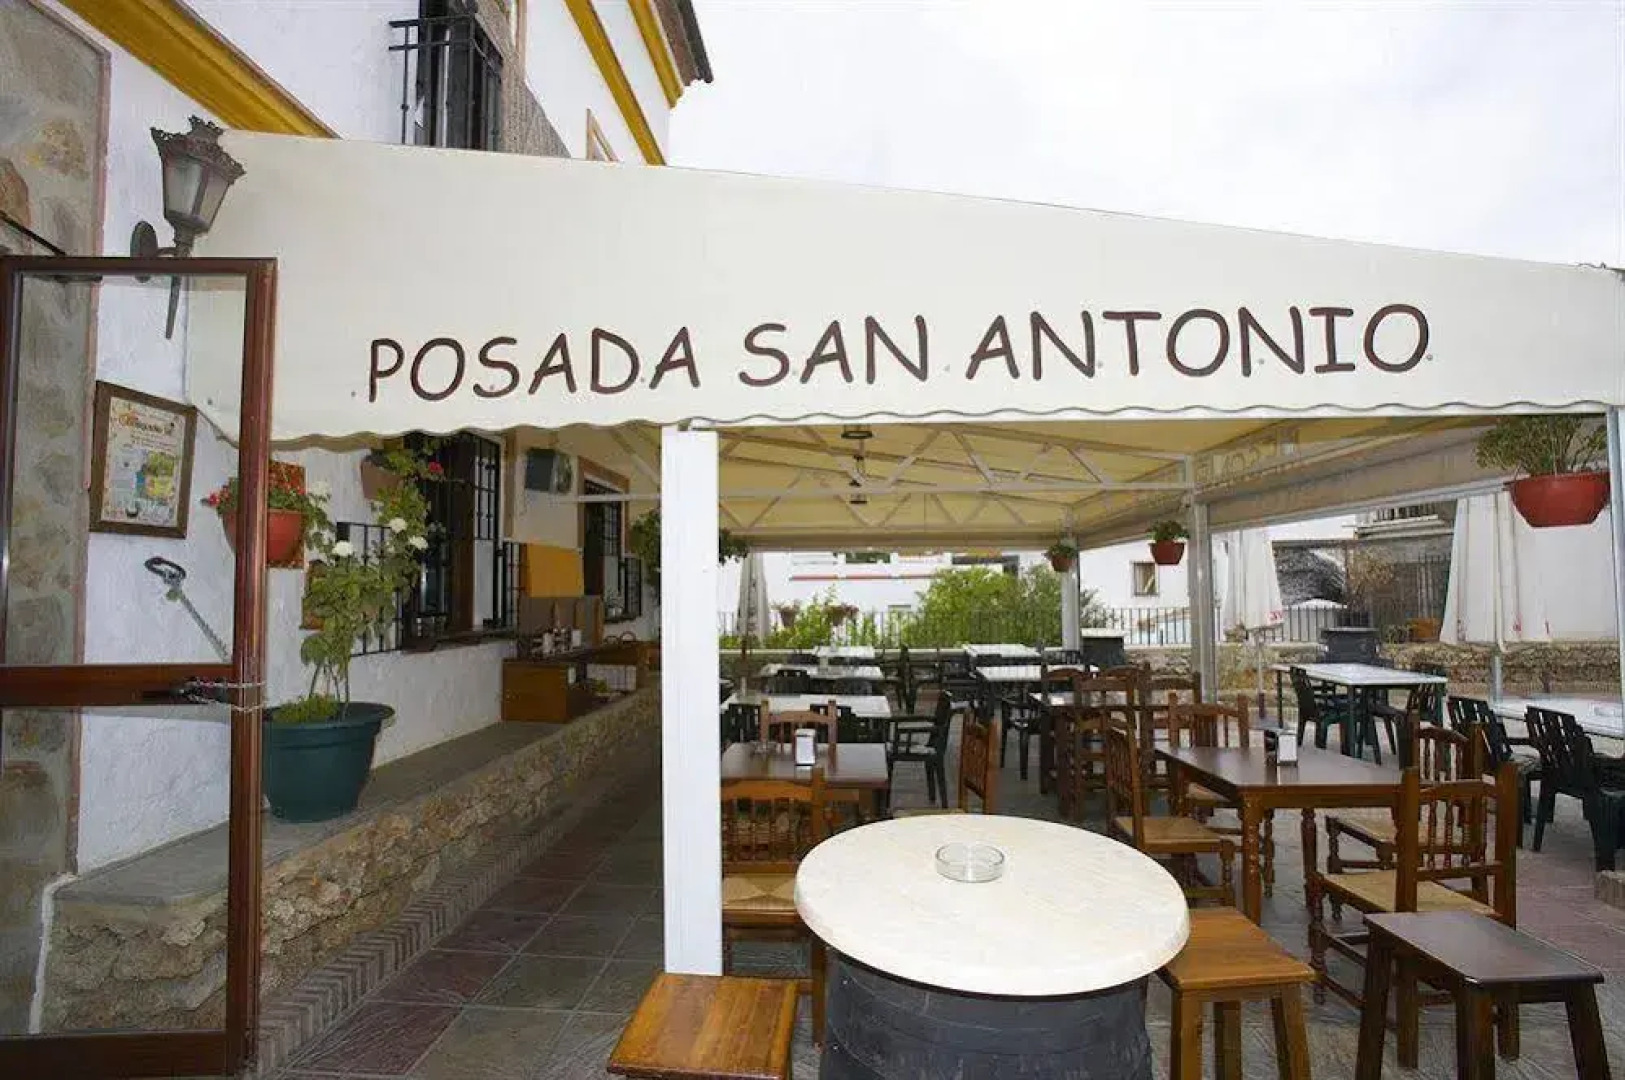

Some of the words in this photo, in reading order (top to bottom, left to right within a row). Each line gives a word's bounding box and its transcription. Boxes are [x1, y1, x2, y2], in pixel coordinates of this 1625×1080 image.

[369, 326, 701, 402] POSADA
[738, 314, 929, 387] SAN
[965, 303, 1430, 381] ANTONIO
